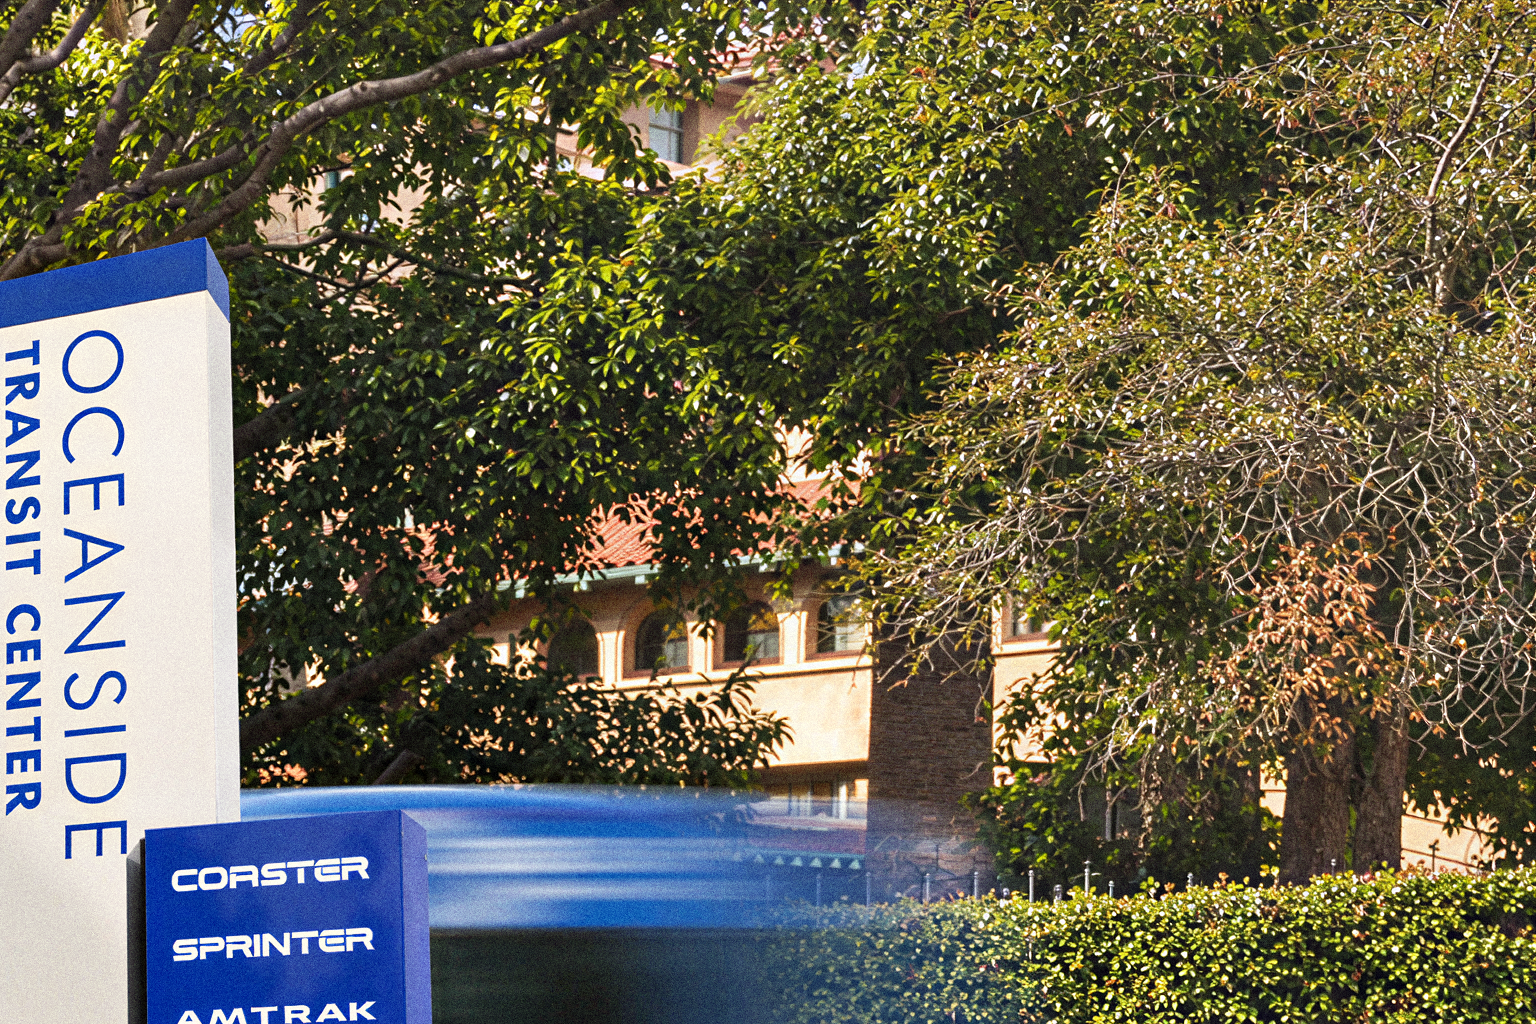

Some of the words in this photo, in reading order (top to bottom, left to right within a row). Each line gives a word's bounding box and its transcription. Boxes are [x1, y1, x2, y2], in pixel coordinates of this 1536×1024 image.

[5, 340, 41, 575] TRANSIT
[62, 330, 127, 859] OCEANSIDE
[5, 604, 42, 816] CENTER
[172, 856, 370, 892] COASTER
[172, 927, 375, 962] SPRINTER
